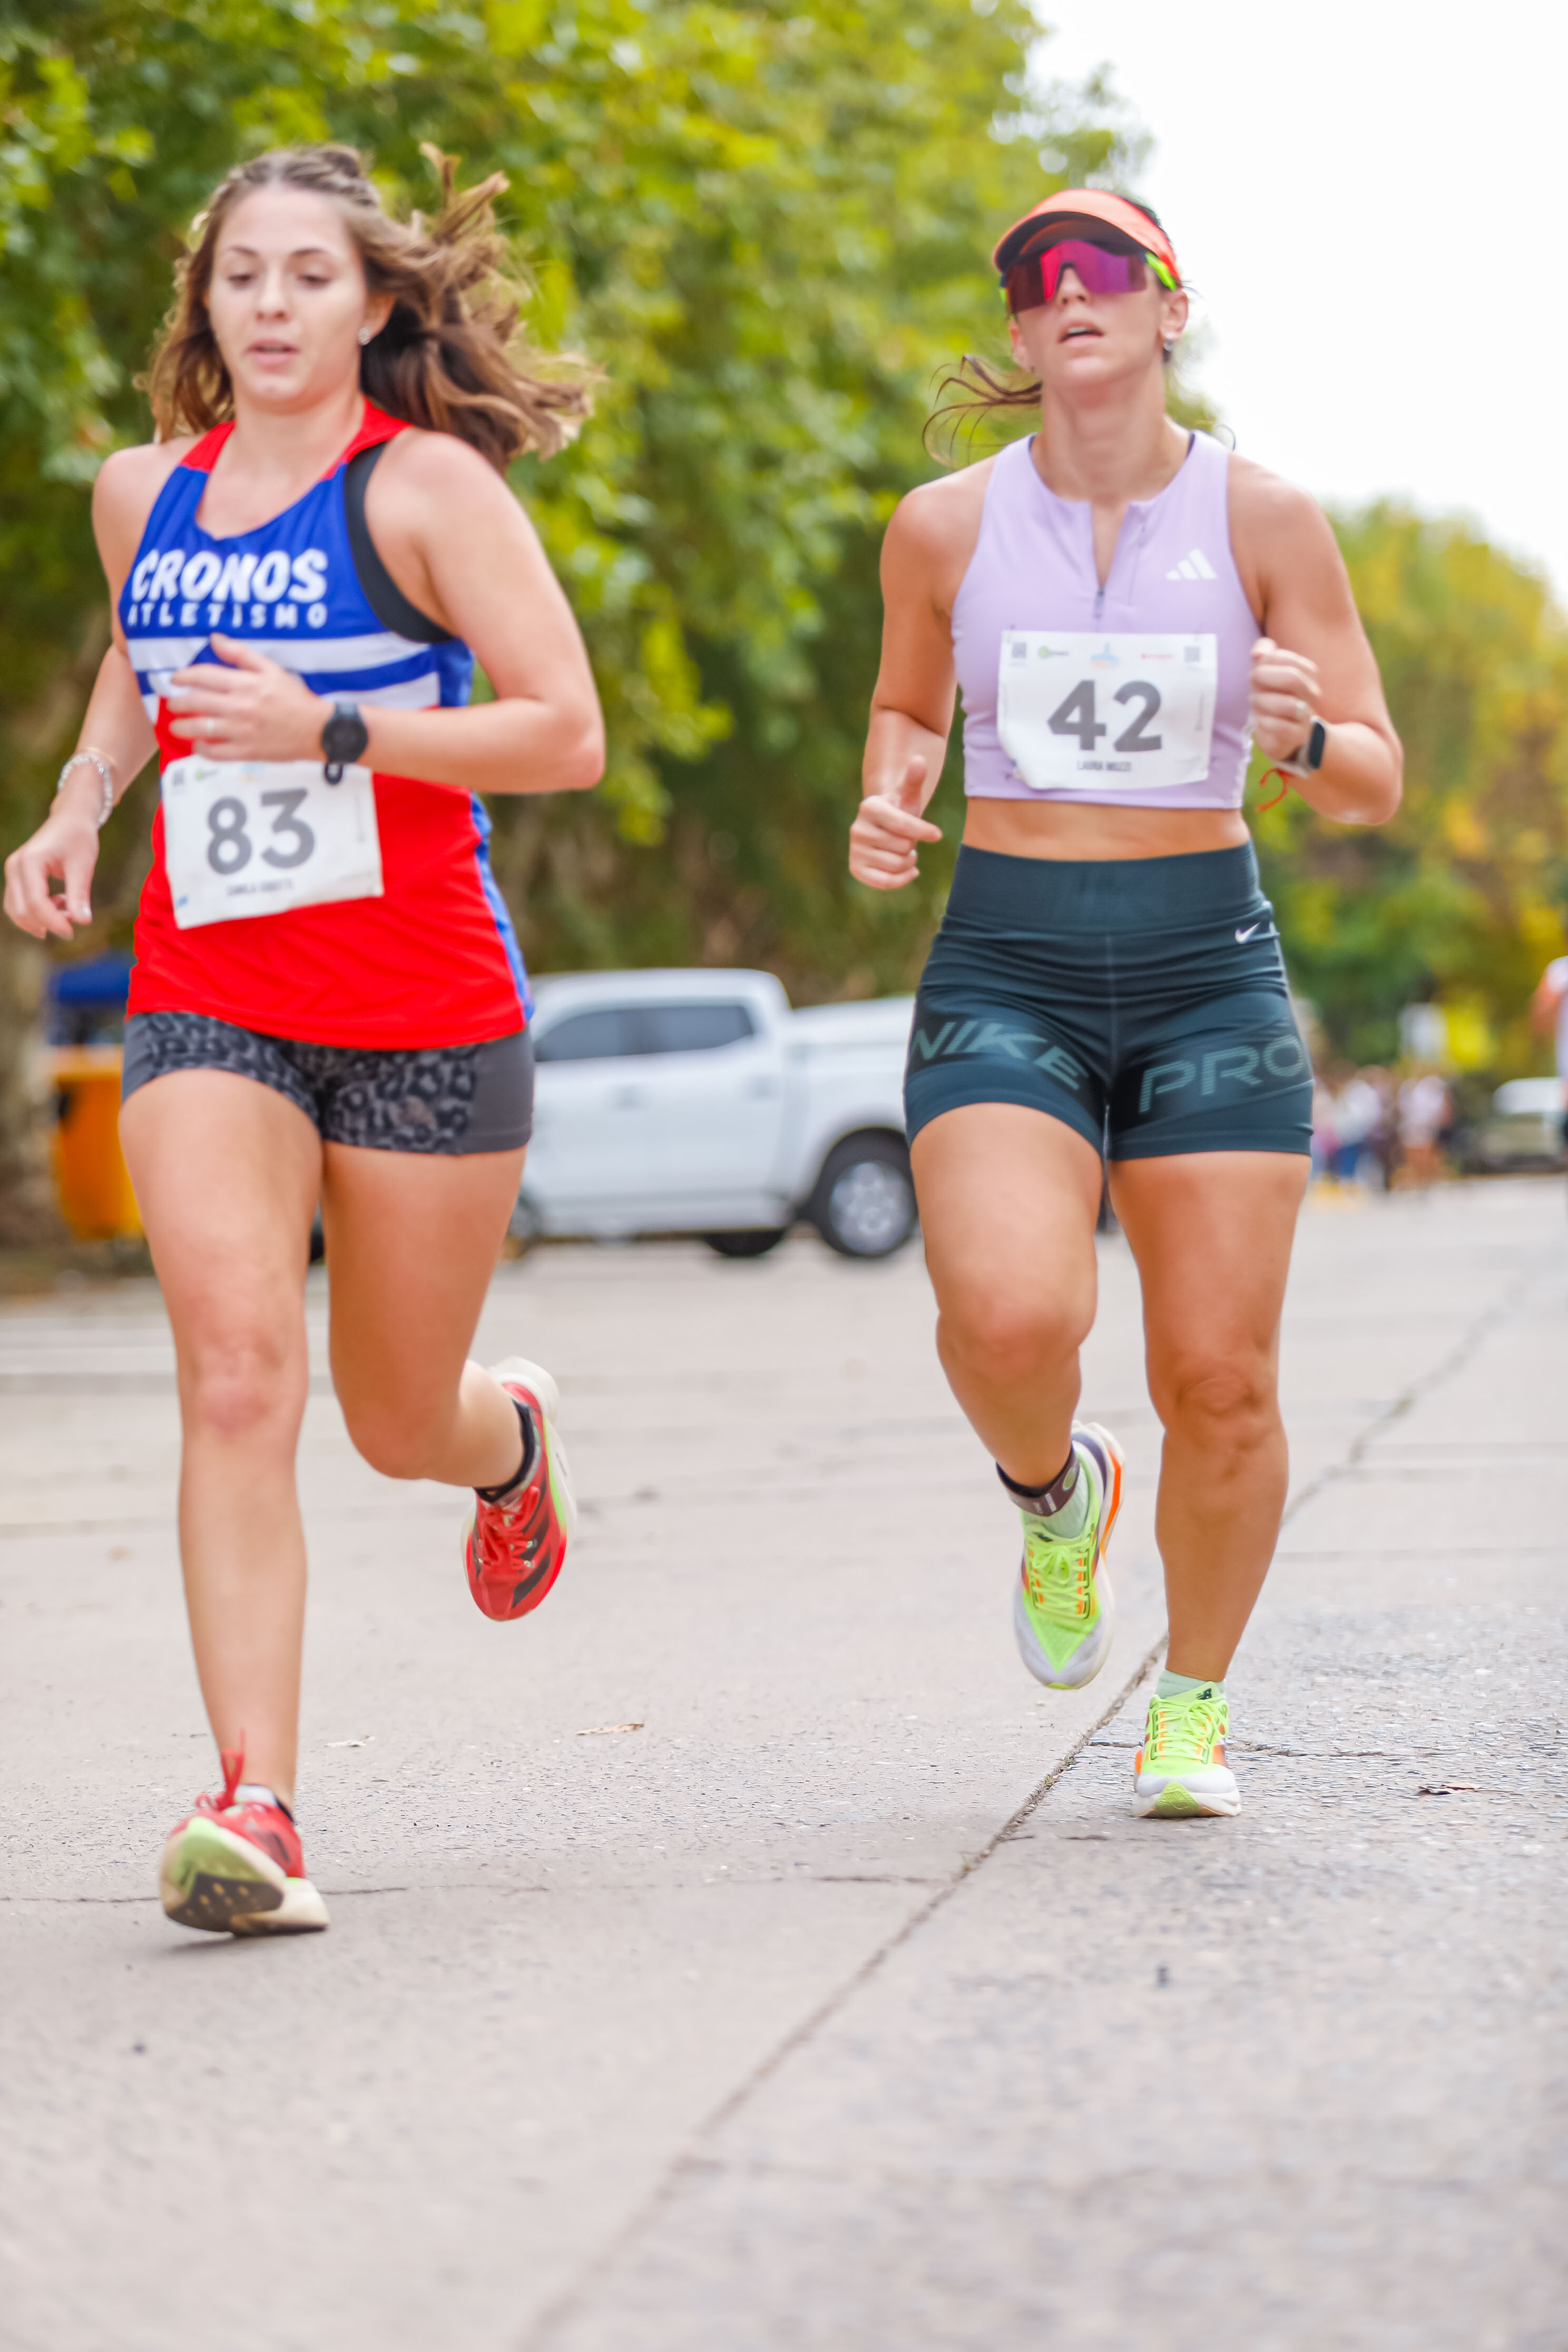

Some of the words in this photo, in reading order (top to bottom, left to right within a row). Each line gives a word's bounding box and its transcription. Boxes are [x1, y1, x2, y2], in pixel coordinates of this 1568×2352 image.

[131, 548, 328, 604] CRONOS
[1047, 679, 1162, 752] 42
[207, 787, 315, 875] 83
[909, 1020, 1089, 1090] NIKE
[1139, 1034, 1305, 1114] PRO
